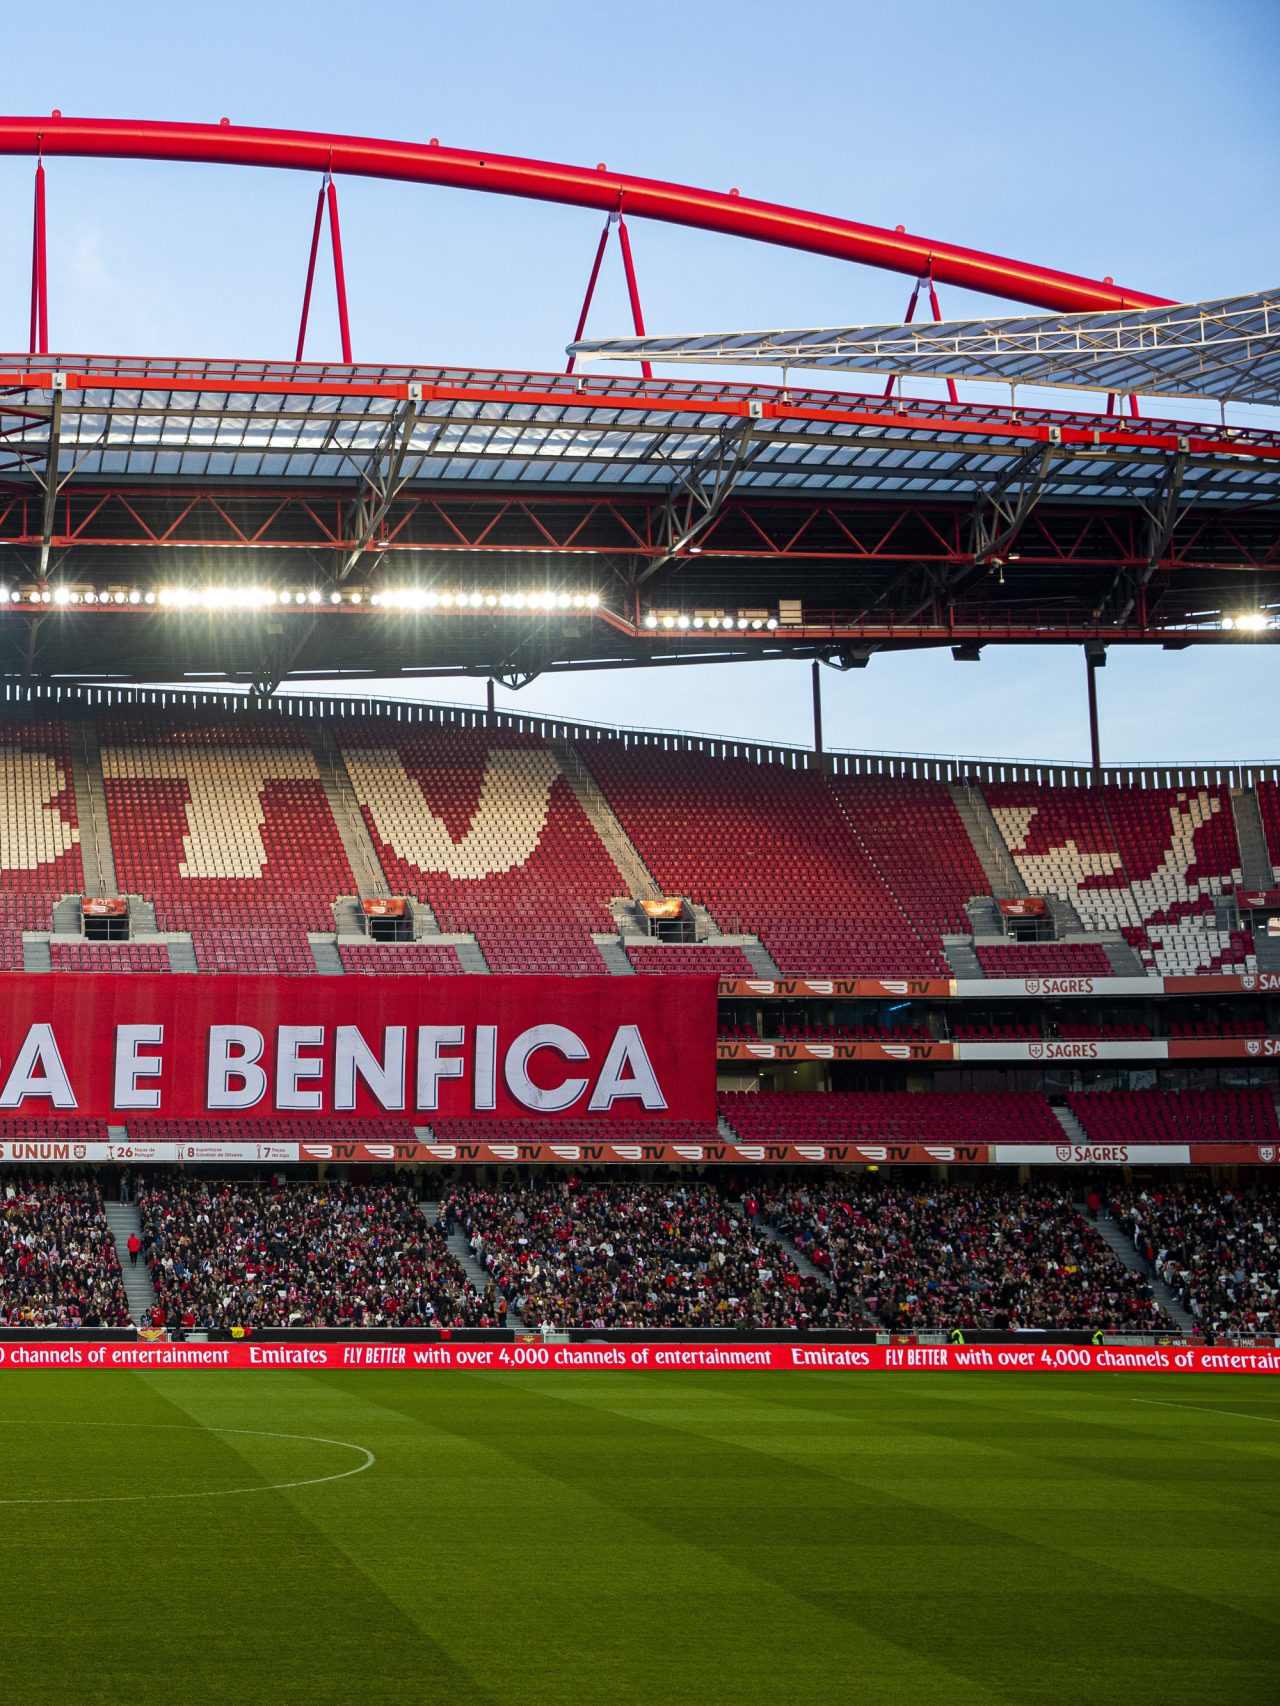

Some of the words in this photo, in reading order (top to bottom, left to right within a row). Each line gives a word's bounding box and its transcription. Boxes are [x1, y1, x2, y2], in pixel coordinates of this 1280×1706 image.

[1043, 978, 1094, 993] SAGRES
[1259, 974, 1280, 990] SA
[1046, 1043, 1098, 1059] SAGRES
[113, 1023, 164, 1109] E
[207, 1023, 669, 1112] BENFICA
[12, 1144, 70, 1159] UNUM
[117, 1147, 133, 1158] 26
[187, 1147, 195, 1158] 8
[264, 1147, 271, 1158] 7
[1074, 1146, 1128, 1162] SAGRES
[10, 1346, 83, 1363] channels
[87, 1346, 107, 1363] of
[111, 1347, 230, 1364] entertainment
[249, 1346, 328, 1364] Emirates
[343, 1347, 364, 1364] FLY
[365, 1347, 407, 1364] BETTER
[413, 1347, 451, 1364] with
[456, 1351, 494, 1364] over
[498, 1347, 549, 1367] 4,000
[554, 1348, 626, 1365] channels
[631, 1347, 650, 1364] of
[655, 1348, 772, 1365] entertainment
[791, 1347, 870, 1366] Emirates
[885, 1349, 905, 1366] FLY
[907, 1348, 948, 1366] BETTER
[954, 1348, 993, 1365] with
[997, 1352, 1036, 1366] over
[1040, 1349, 1091, 1368] 4,000
[1096, 1350, 1170, 1367] channels
[1174, 1350, 1195, 1367] of
